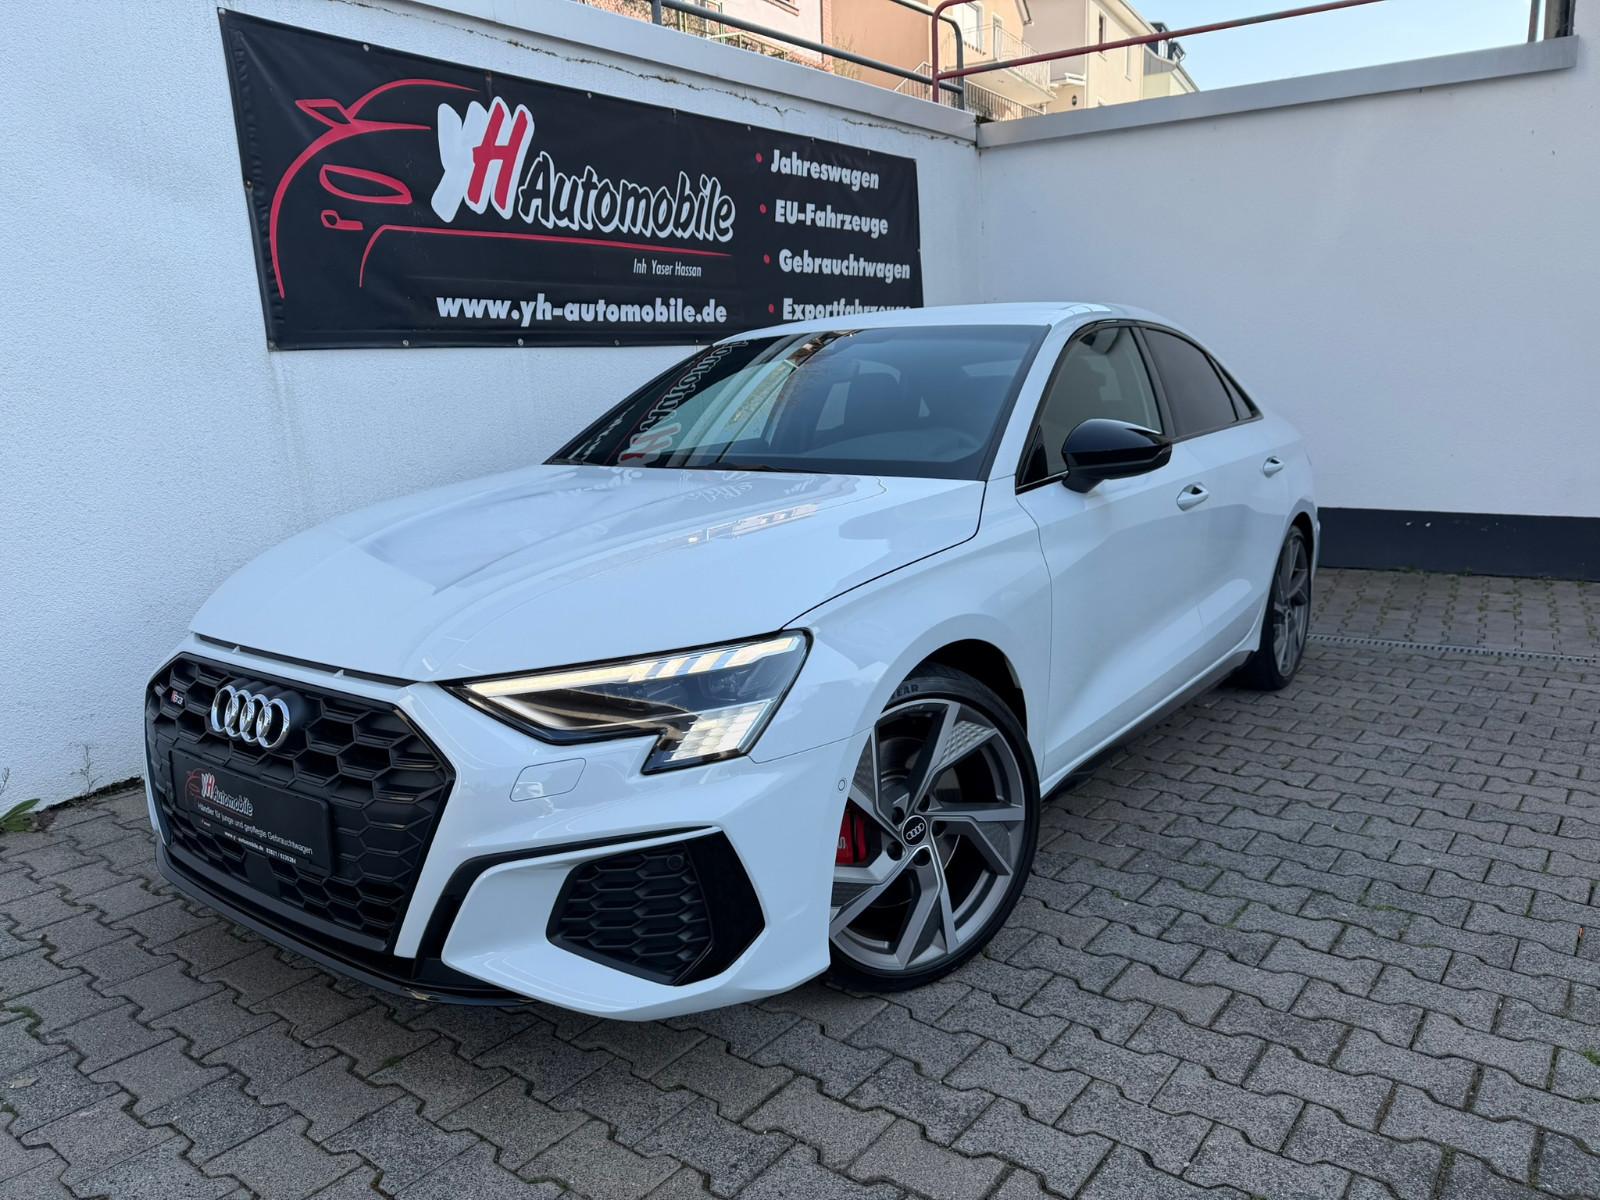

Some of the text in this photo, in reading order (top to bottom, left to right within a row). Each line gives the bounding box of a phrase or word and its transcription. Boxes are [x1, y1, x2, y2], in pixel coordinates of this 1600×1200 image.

[431, 96, 735, 242] YH Automobile
[771, 149, 880, 191] Jahreswagen
[775, 199, 889, 239] EU-Fahrzeuge
[633, 258, 702, 277] Inh Yaser Hassan
[779, 249, 911, 284] Gebrauchtwagen
[436, 293, 728, 327] www.yh-automobile.de
[783, 298, 912, 320] Exportfah
